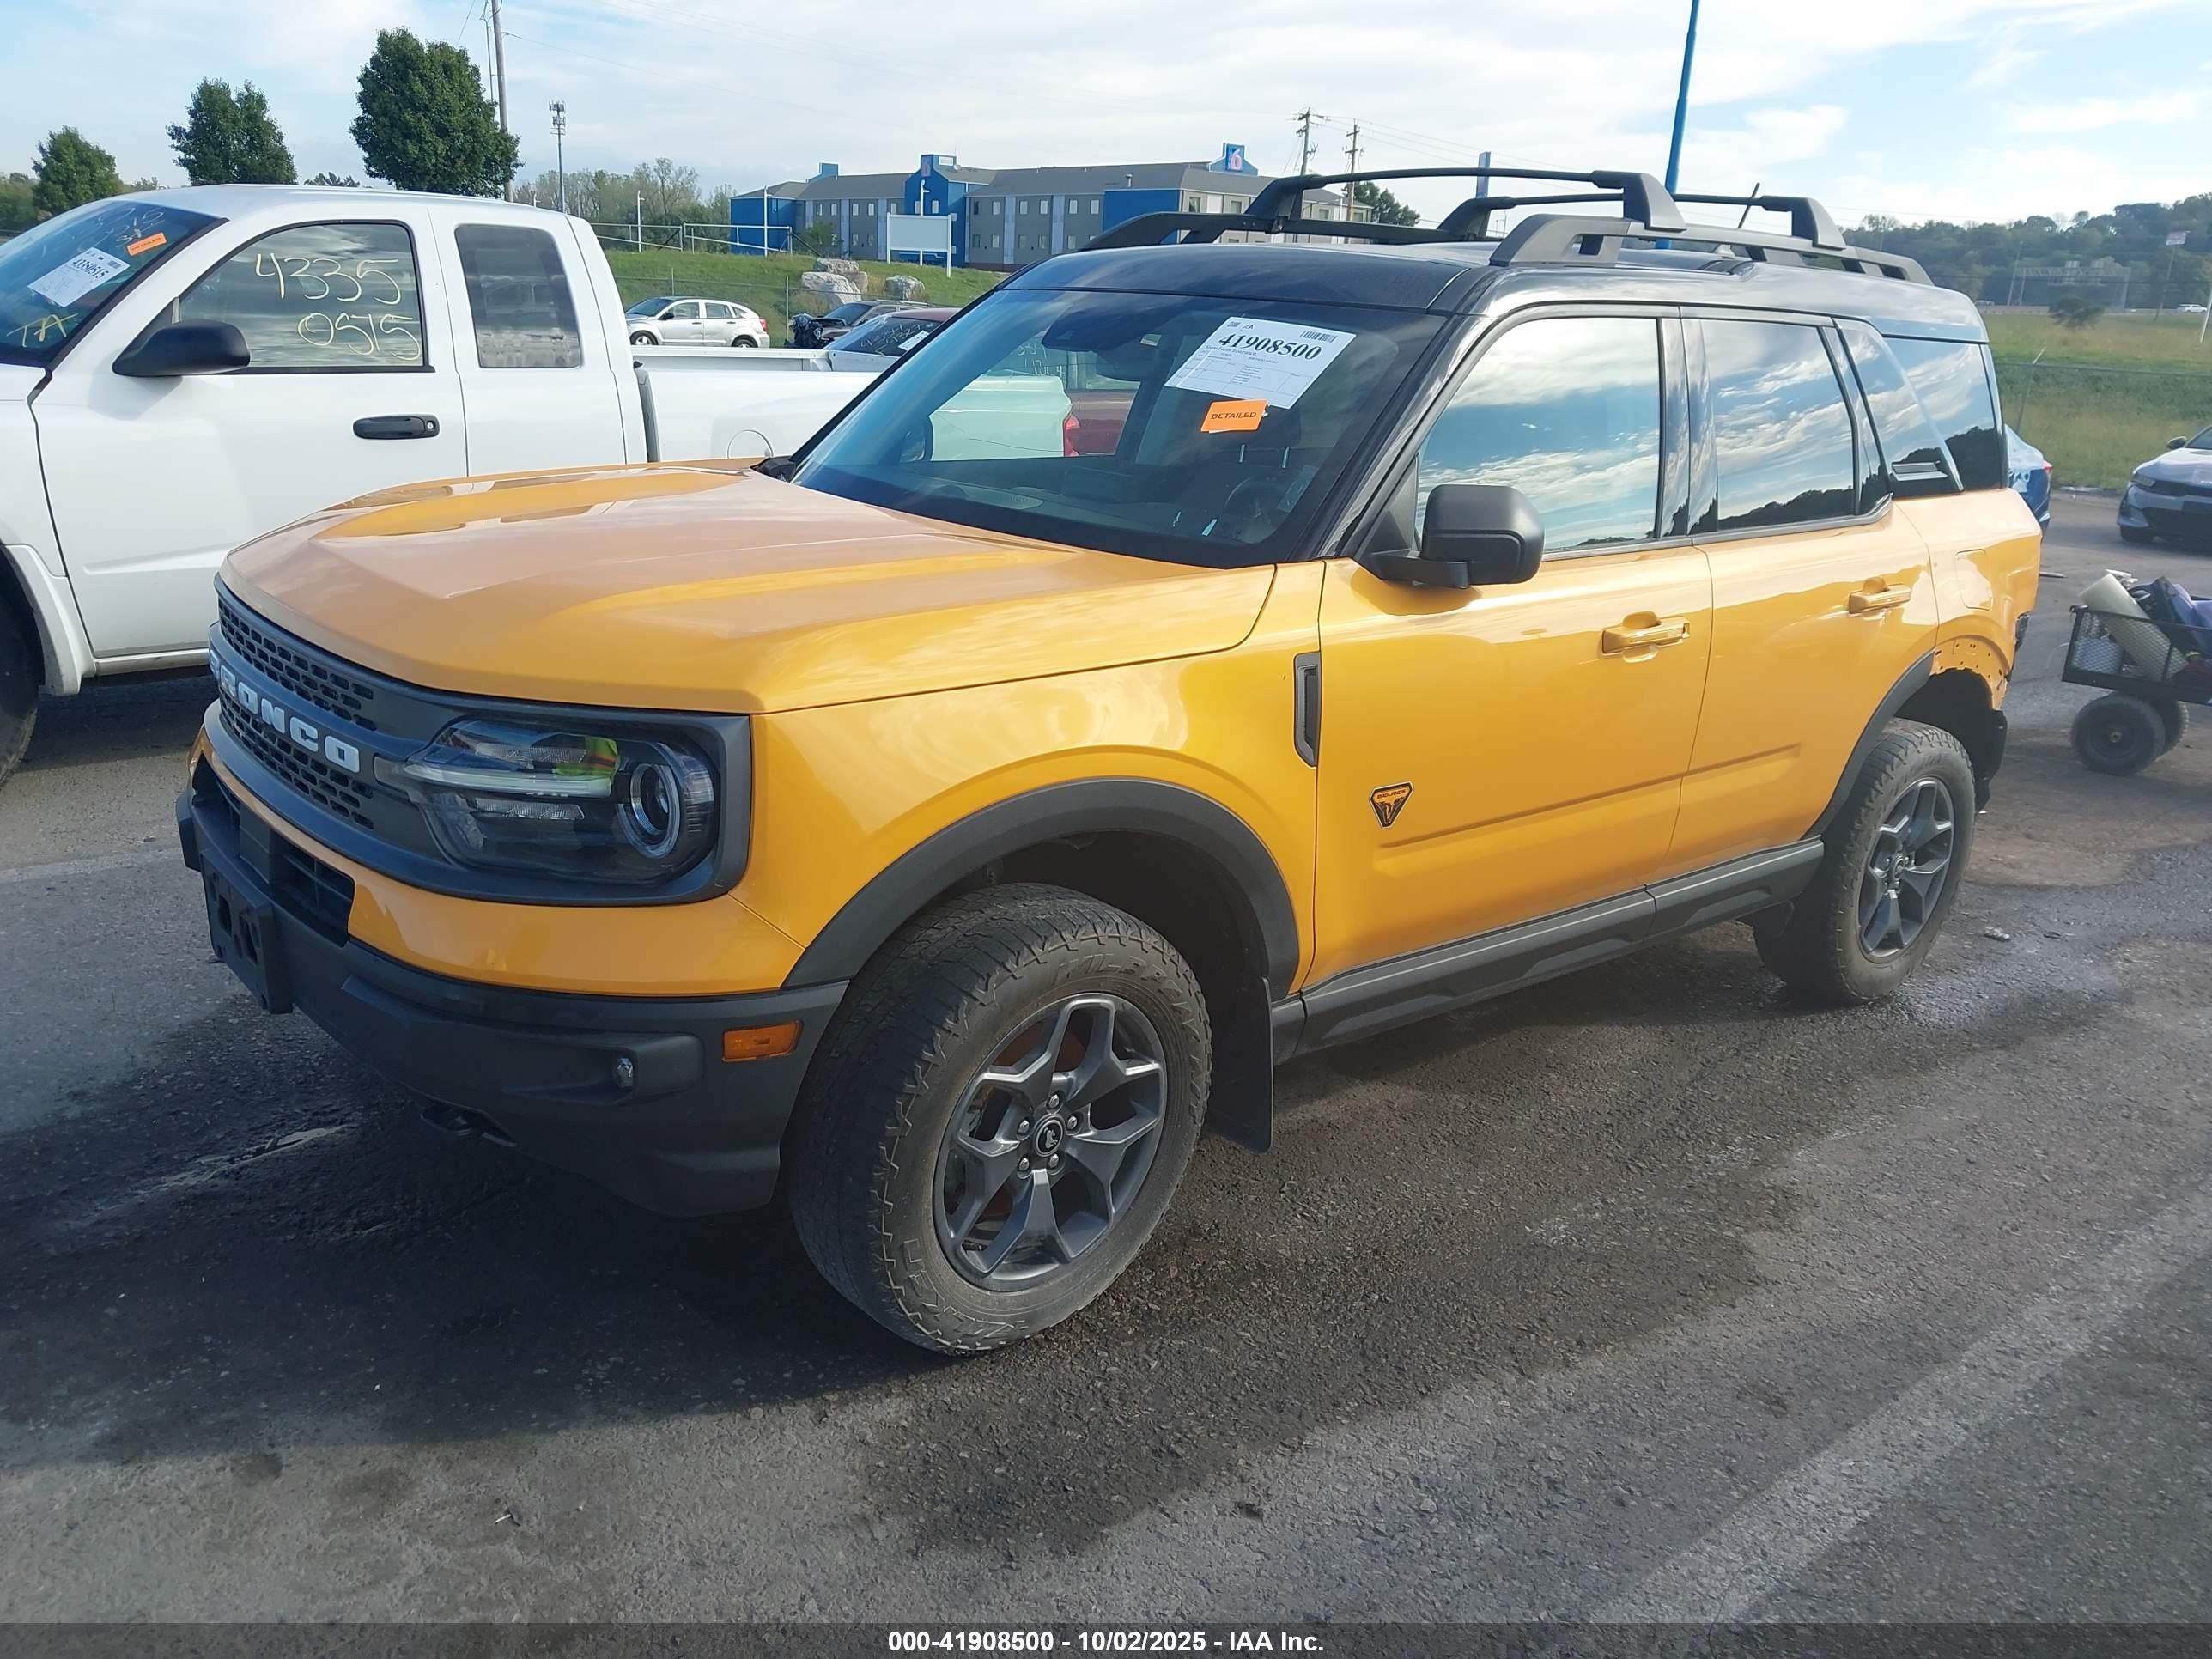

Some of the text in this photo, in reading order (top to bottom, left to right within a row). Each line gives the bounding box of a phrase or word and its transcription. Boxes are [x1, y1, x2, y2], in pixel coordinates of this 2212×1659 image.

[255, 252, 401, 306] 4335
[297, 312, 421, 361] 0515
[1218, 333, 1322, 361] 41908500
[1210, 411, 1257, 420] DETAILED
